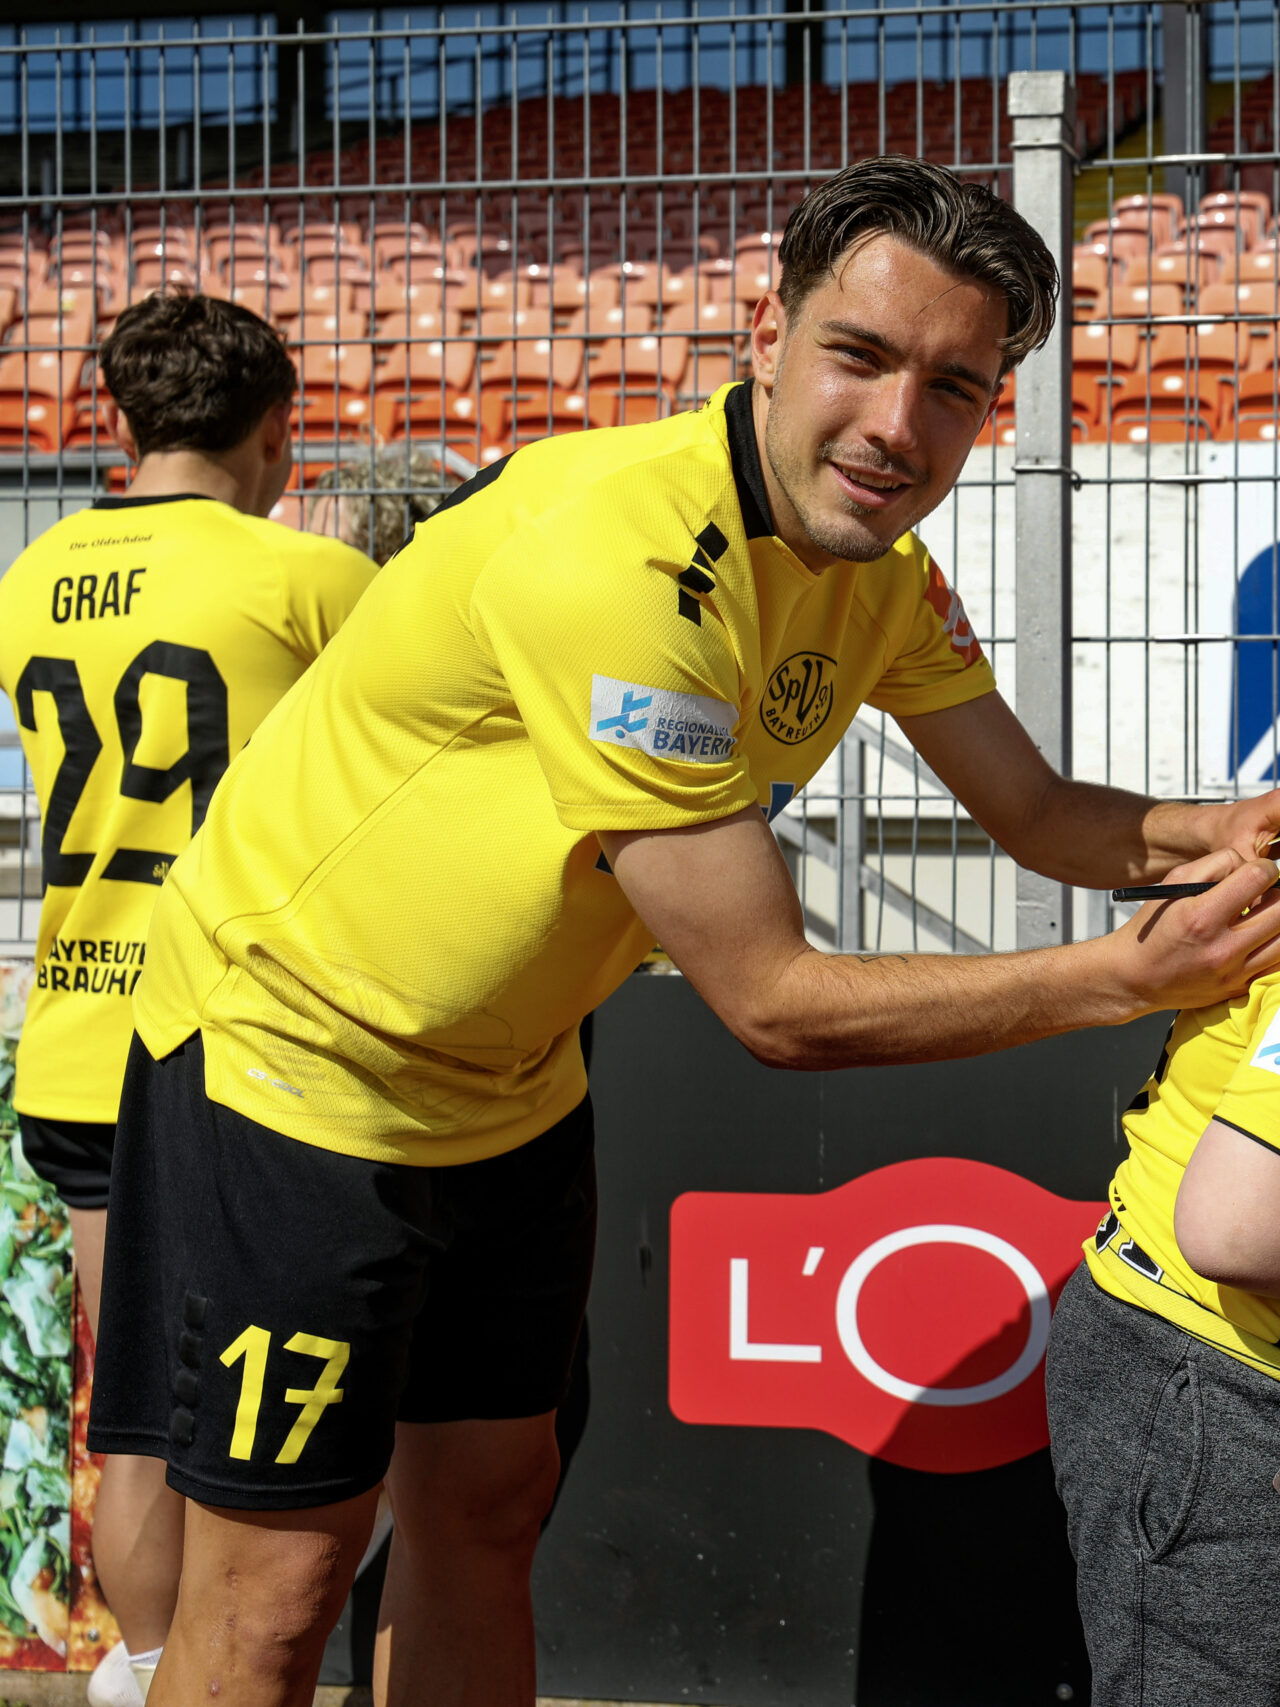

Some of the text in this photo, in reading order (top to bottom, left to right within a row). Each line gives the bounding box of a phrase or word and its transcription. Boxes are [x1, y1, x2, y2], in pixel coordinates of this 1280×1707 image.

[51, 566, 147, 624] GRAF
[765, 707, 821, 740] BAYREUTH
[653, 729, 736, 757] BAYERN
[15, 639, 230, 898] 29
[49, 937, 146, 965] AYREUT
[37, 964, 142, 996] BRAUH
[219, 1324, 351, 1465] 17
